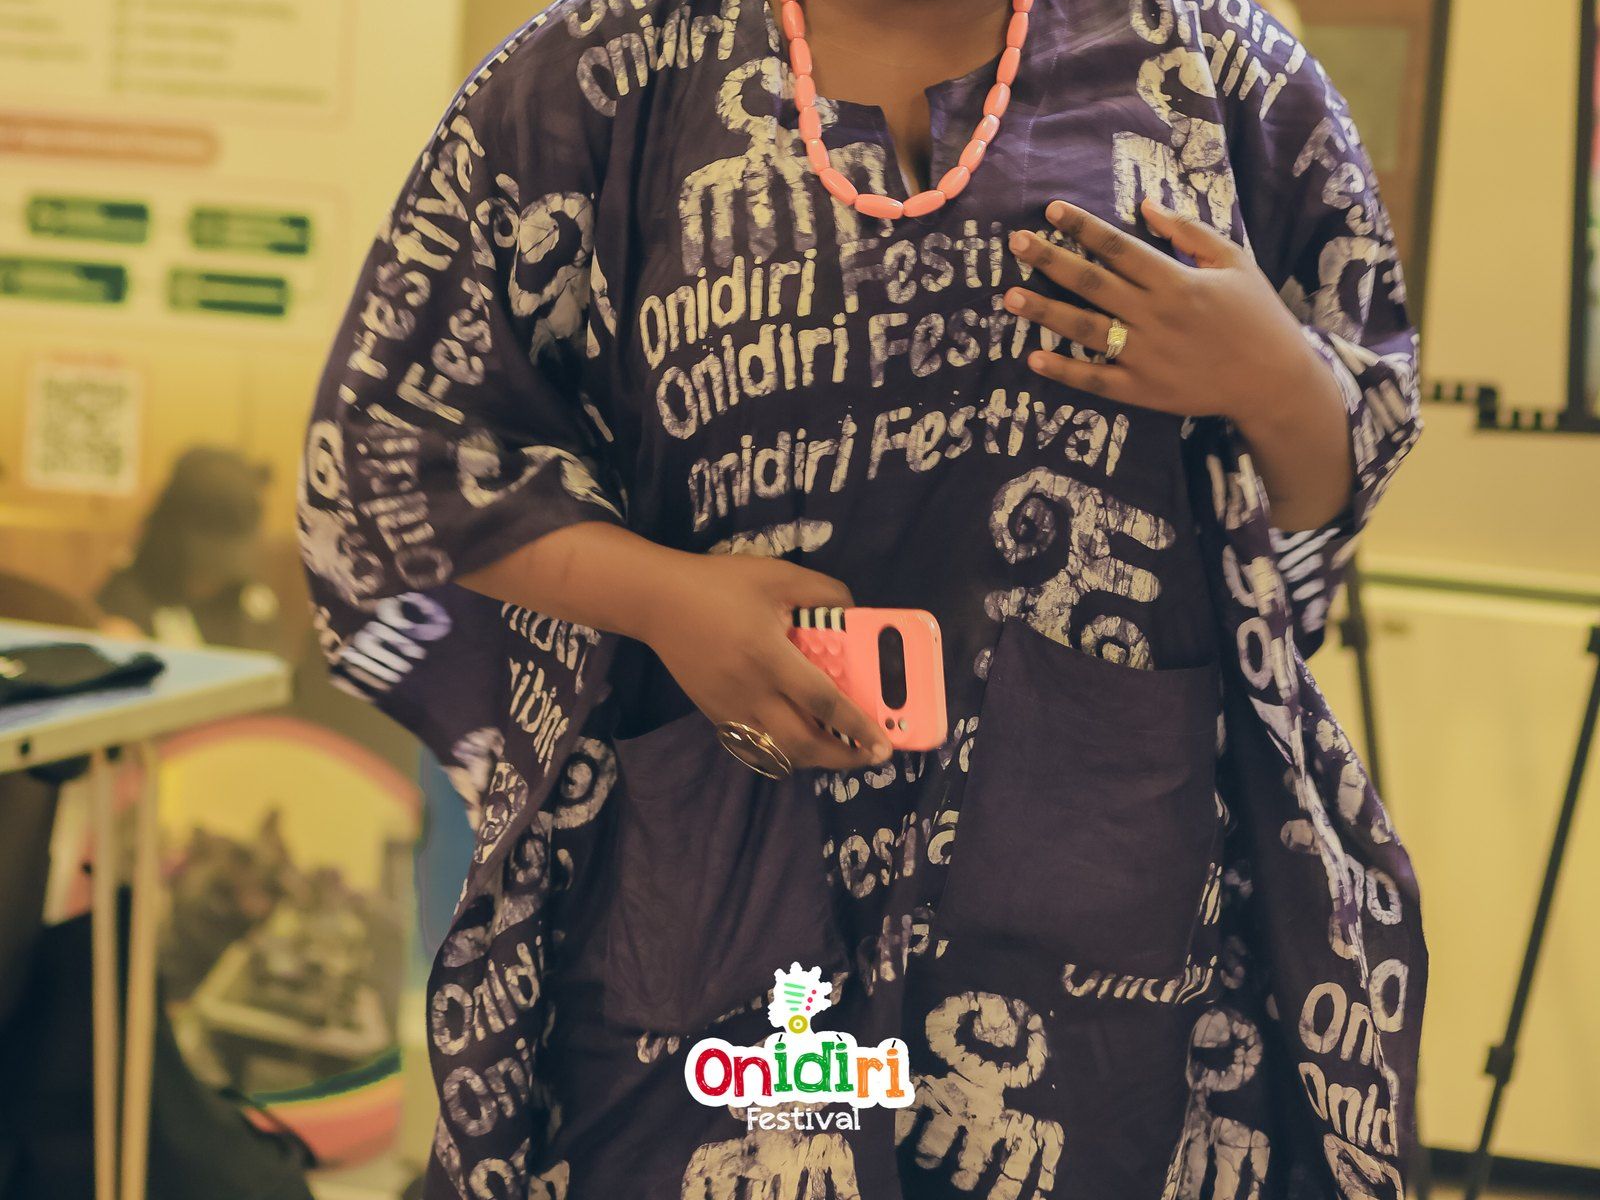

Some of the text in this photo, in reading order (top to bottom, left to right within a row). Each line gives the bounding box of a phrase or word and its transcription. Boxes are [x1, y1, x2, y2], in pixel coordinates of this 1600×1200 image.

[639, 248, 817, 370] Onidiri
[656, 312, 849, 440] Onidiri
[688, 388, 1130, 532] Onidiri Festival
